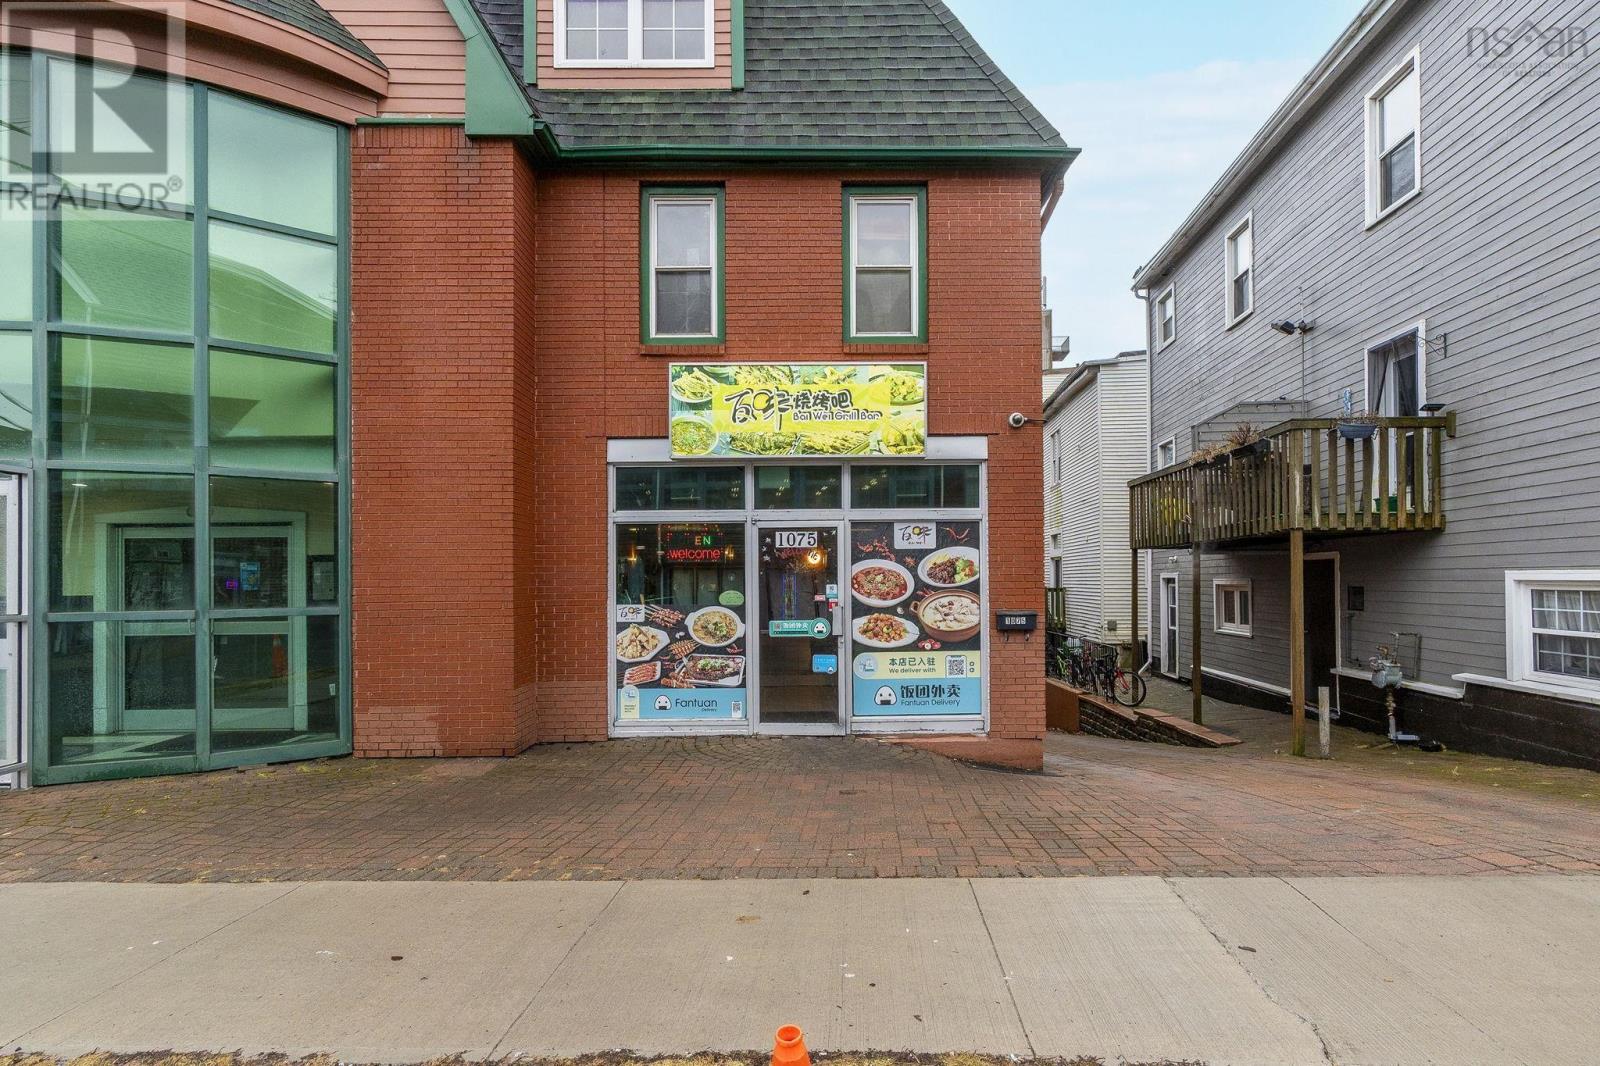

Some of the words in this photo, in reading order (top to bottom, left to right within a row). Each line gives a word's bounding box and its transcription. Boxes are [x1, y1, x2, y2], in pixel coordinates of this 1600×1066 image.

[793, 411, 809, 420] Bai
[813, 411, 831, 420] Wei
[834, 411, 857, 420] Grill
[860, 411, 880, 420] Bar
[777, 532, 817, 546] 1075
[670, 548, 721, 559] welcome
[901, 684, 961, 699] 饭团外卖
[675, 698, 718, 708] Fantuan
[931, 698, 961, 707] Delivery
